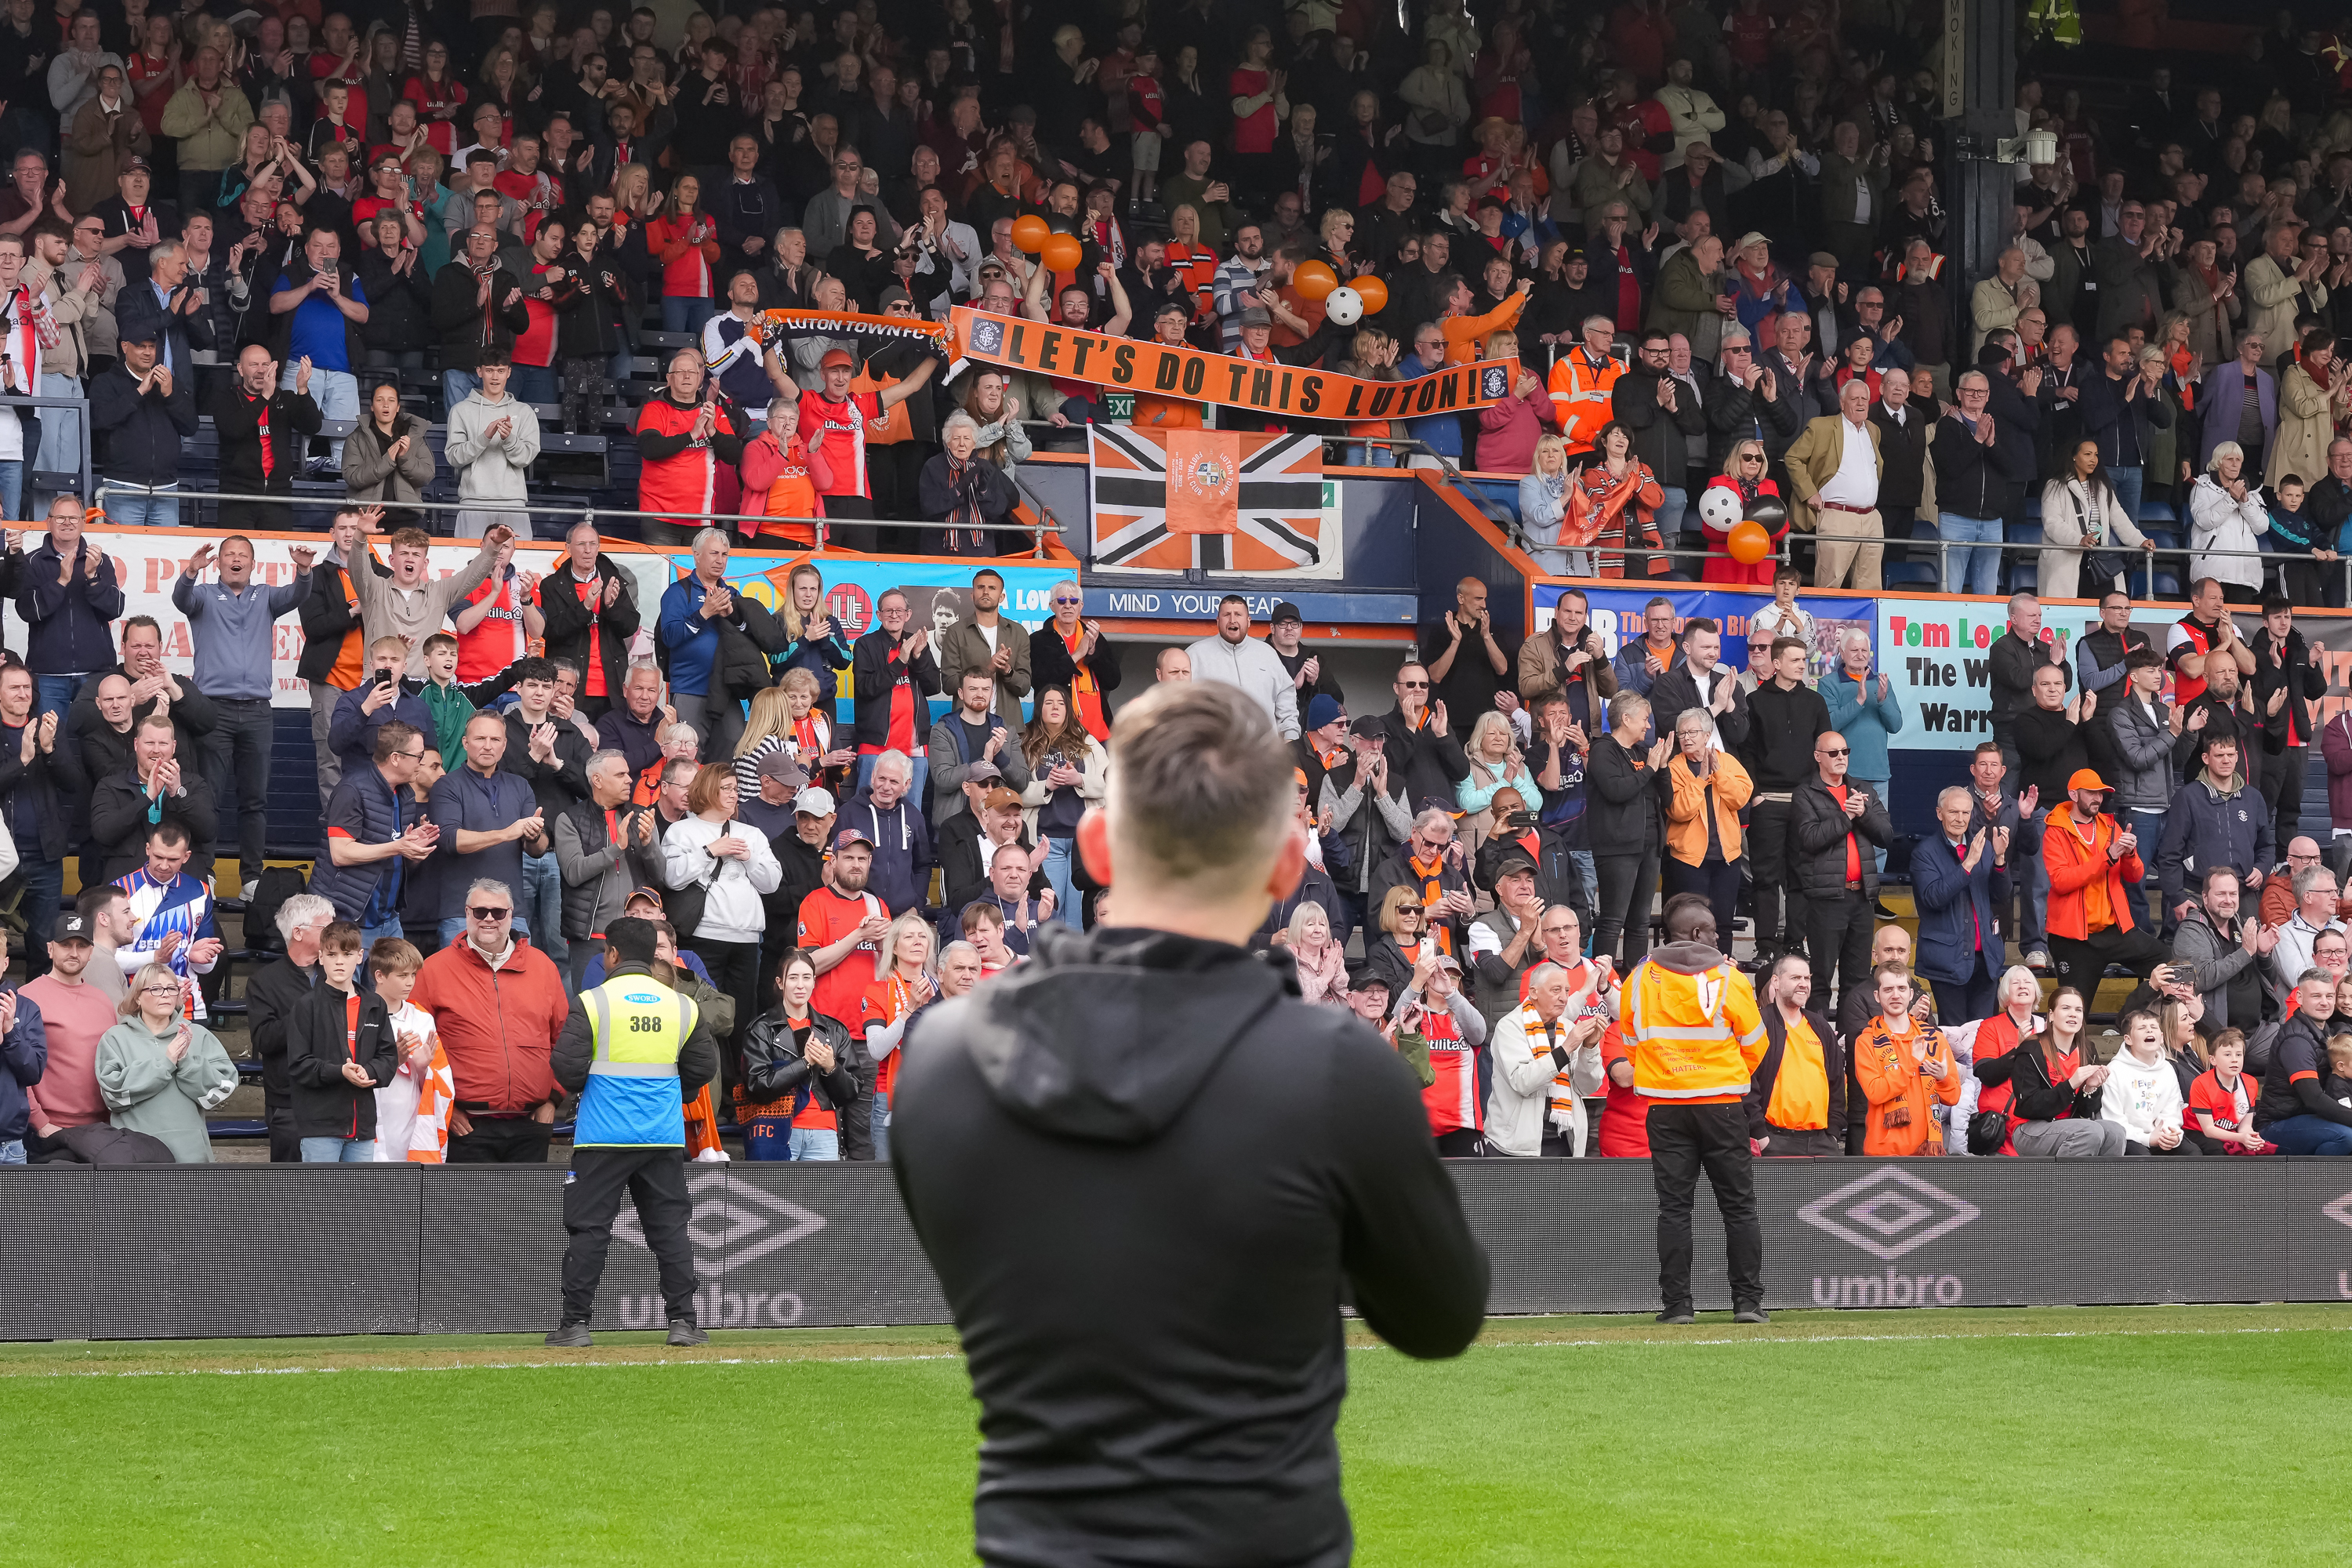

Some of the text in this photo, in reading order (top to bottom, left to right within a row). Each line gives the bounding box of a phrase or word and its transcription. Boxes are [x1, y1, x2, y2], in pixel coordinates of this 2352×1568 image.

[786, 317, 927, 339] LUTON TOWN FC
[975, 321, 1000, 334] LUTON TOWN
[1008, 324, 1136, 384] LET'S
[1154, 352, 1206, 396] DO
[1228, 363, 1323, 413] THIS
[1484, 368, 1494, 379] LUTON
[1187, 451, 1203, 496] FOOTBALL CLUB
[1218, 452, 1234, 497] LUTON TOWN
[485, 607, 513, 620] tilita
[1109, 593, 1284, 615] MIND YOUR EAD
[1889, 616, 1950, 648] Tom
[1906, 657, 1957, 688] The
[628, 994, 658, 1003] SWORD
[630, 1015, 662, 1033] 388
[1878, 1047, 1894, 1062] LUTON
[1671, 1065, 1707, 1073] HATTERS
[1926, 1078, 1936, 1091] LUTO
[1813, 1266, 1963, 1306] umbro
